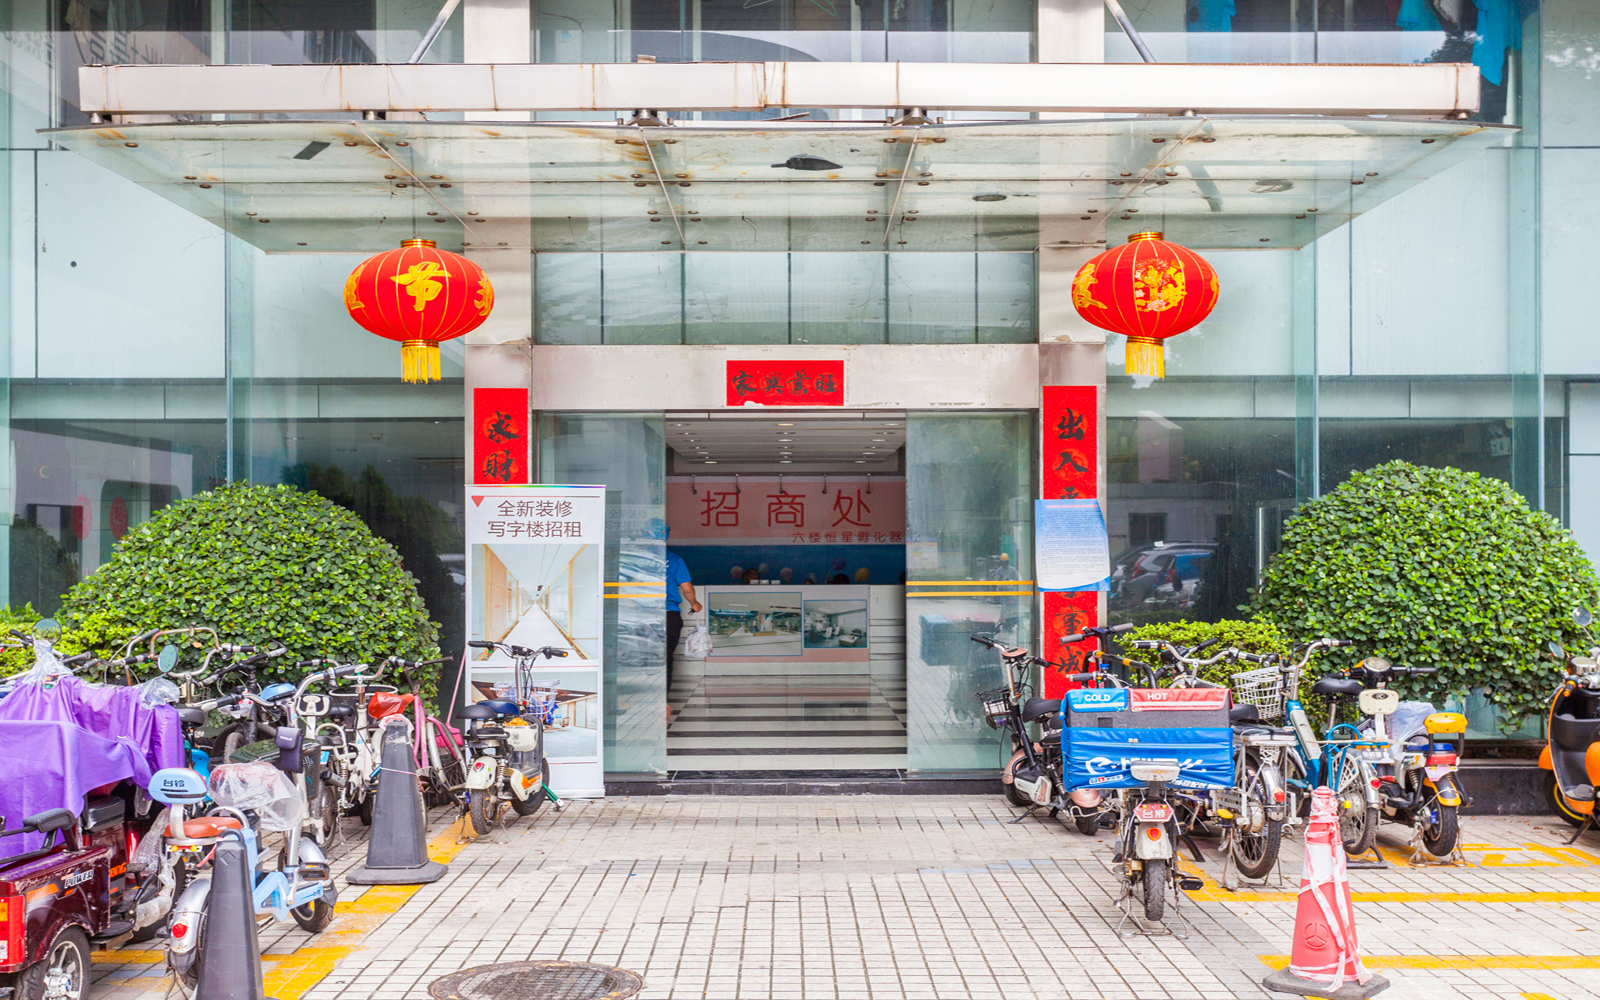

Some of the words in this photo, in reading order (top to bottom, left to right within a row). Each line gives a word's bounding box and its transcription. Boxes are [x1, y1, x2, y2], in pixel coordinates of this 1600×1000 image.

[497, 500, 573, 518] 全新装修
[700, 489, 872, 528] 招商处
[487, 520, 582, 538] 写字楼招租
[792, 531, 902, 543] 六楼恒星孵化器
[1084, 693, 1111, 702] COLD
[1146, 692, 1168, 701] HOT
[64, 869, 95, 889] POWER
